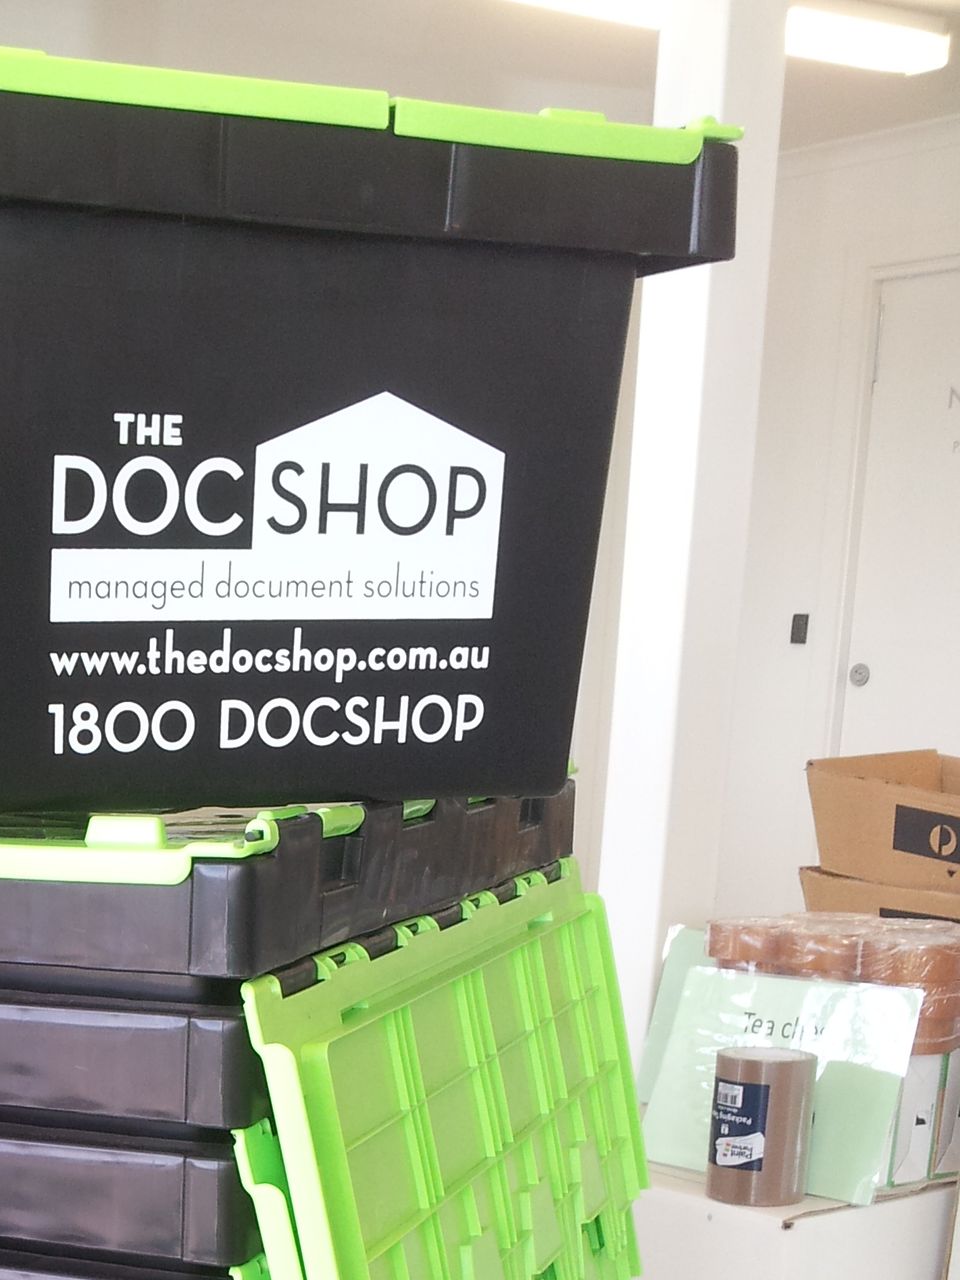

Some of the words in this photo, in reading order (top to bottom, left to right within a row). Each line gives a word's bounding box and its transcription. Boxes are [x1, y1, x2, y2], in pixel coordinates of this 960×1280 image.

[113, 412, 183, 446] THE
[68, 560, 205, 610] managed
[215, 560, 354, 599] document
[363, 561, 480, 599] solutions
[49, 626, 490, 683] www.thedocshop.com.au
[47, 699, 196, 755] 1800
[219, 694, 485, 749] DOCSHOP
